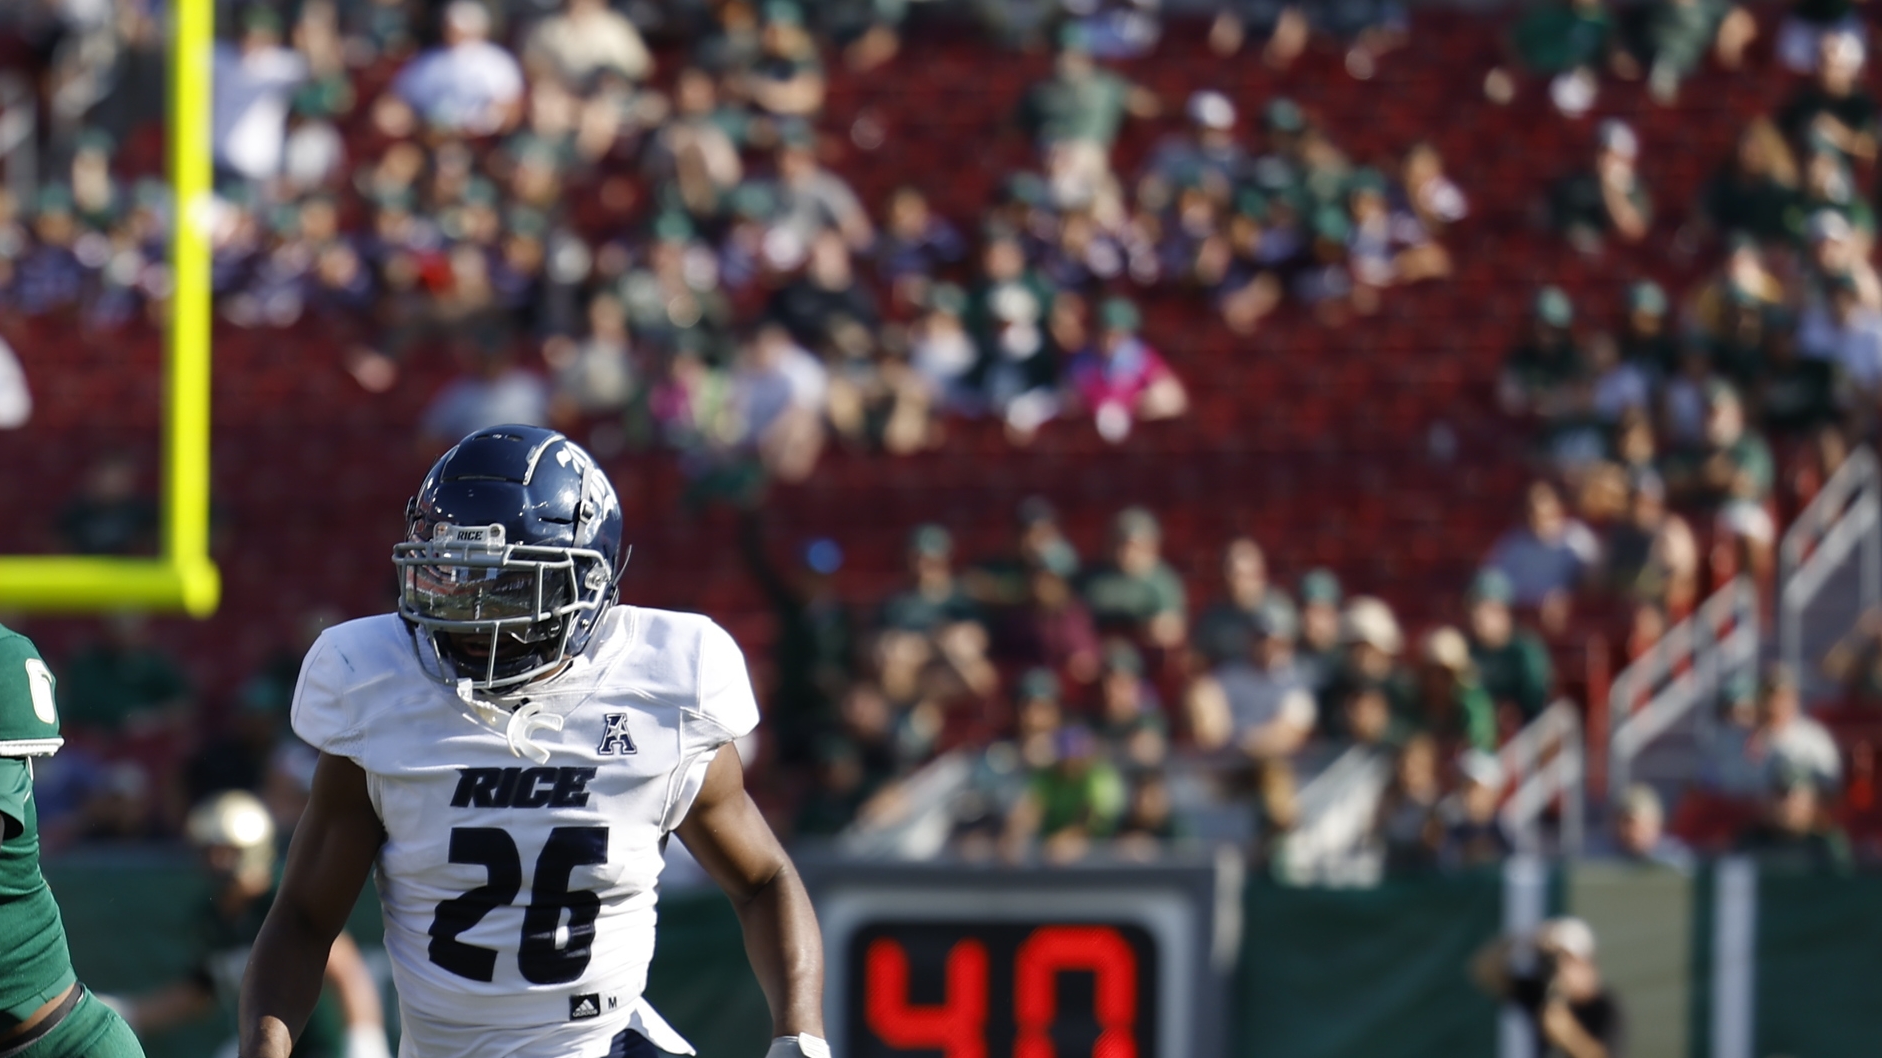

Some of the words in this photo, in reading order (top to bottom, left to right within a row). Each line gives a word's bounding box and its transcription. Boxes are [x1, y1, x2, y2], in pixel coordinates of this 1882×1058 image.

[457, 530, 484, 541] RICE
[449, 766, 598, 809] RICE
[427, 826, 610, 984] 26
